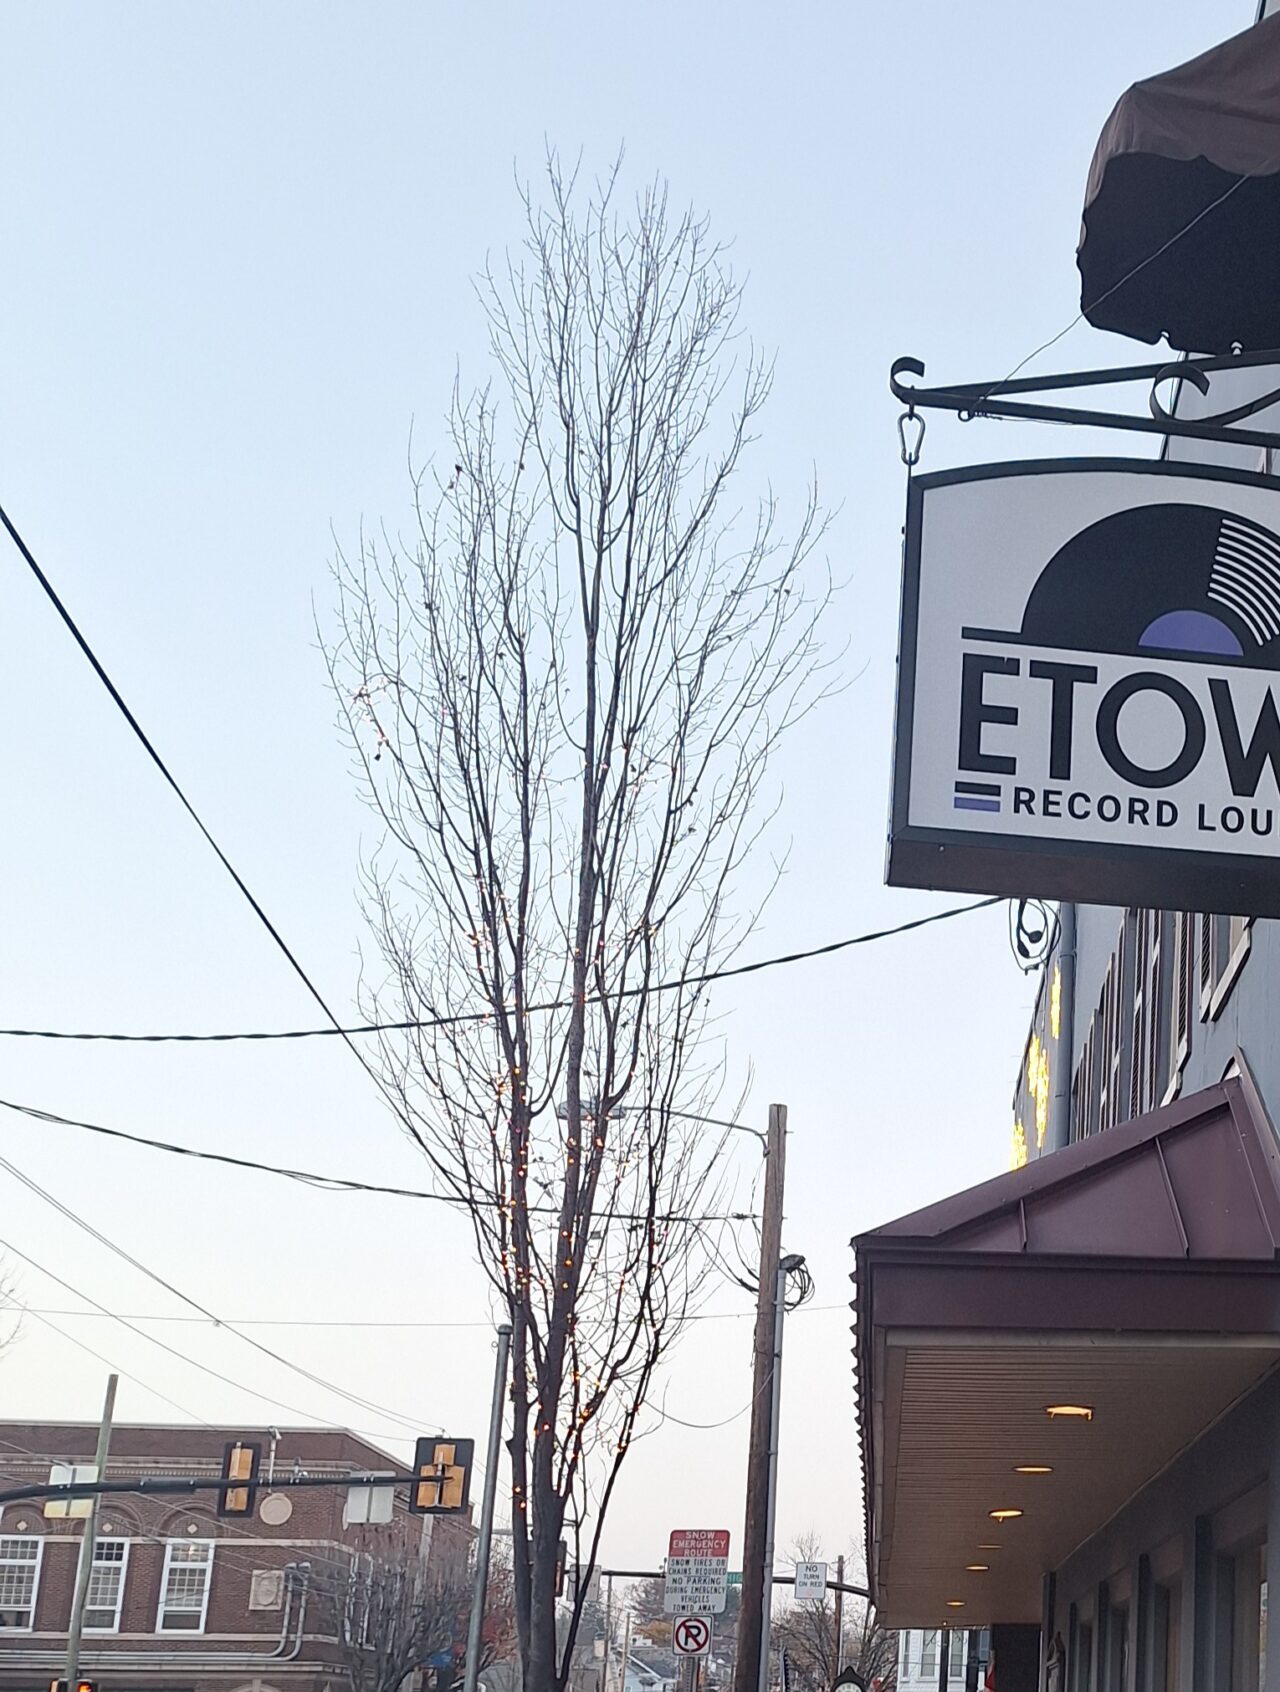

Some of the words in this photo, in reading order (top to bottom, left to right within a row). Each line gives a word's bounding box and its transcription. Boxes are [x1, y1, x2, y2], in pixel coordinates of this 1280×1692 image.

[1013, 786, 1179, 828] RECORD
[685, 1531, 715, 1539] SNOW
[672, 1539, 726, 1548] EMERGENCY
[684, 1549, 713, 1557] ROUTE
[805, 1565, 818, 1573] NO
[672, 1577, 683, 1585] NO
[686, 1577, 721, 1585] PARKING
[665, 1586, 688, 1594] DURING
[690, 1586, 726, 1594] EMERGENCY
[681, 1595, 710, 1603] VEHICLES
[673, 1604, 694, 1612] TOWED
[698, 1604, 716, 1612] AWAY
